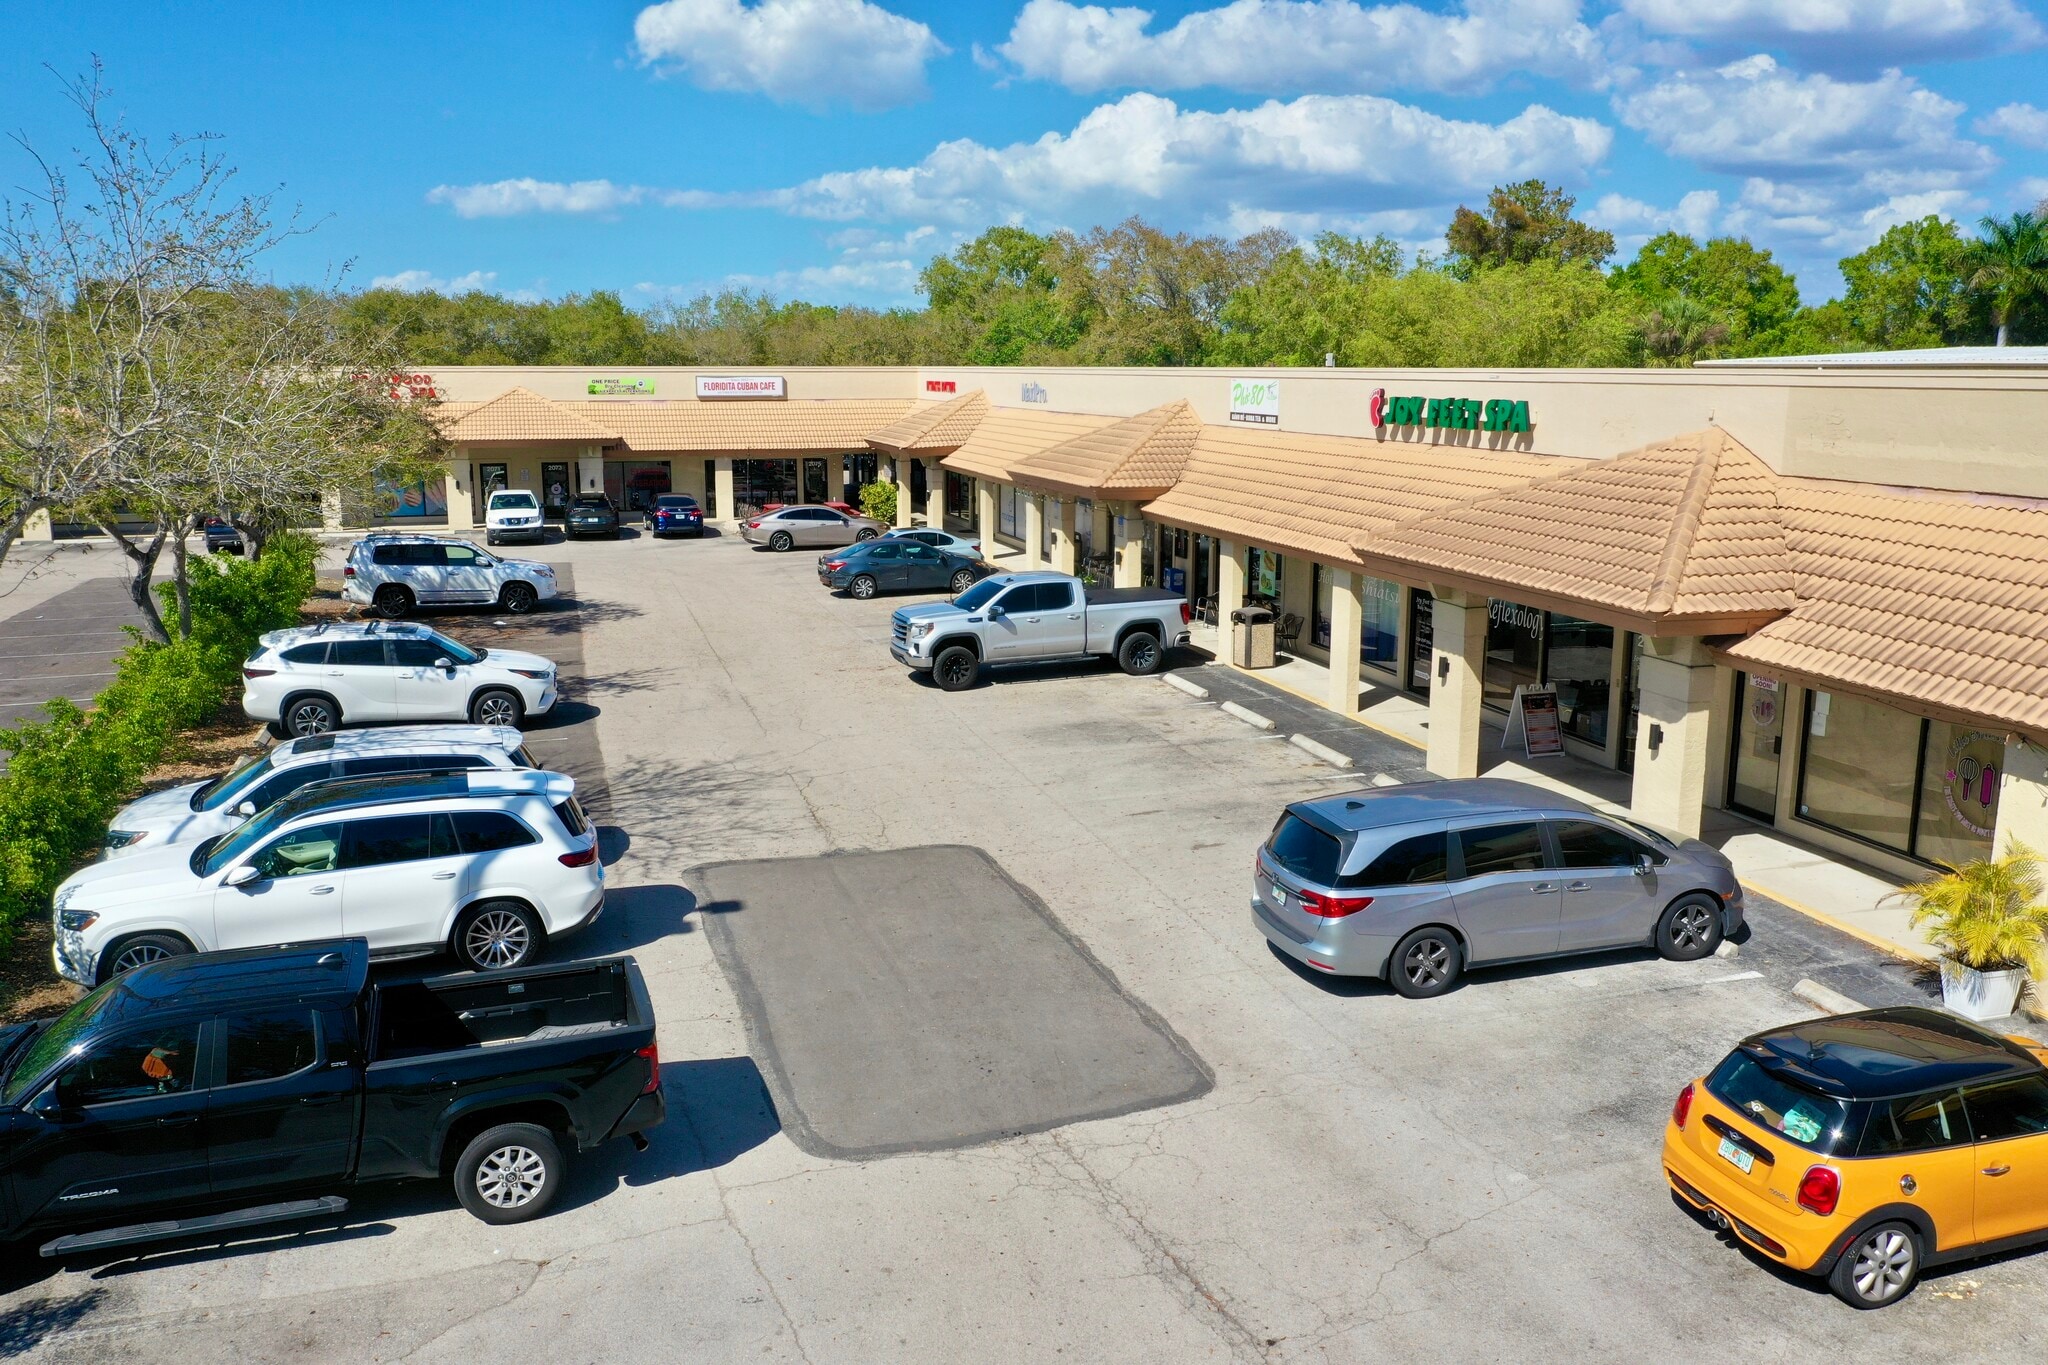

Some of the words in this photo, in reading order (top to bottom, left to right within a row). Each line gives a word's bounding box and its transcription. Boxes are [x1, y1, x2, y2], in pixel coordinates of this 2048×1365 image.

[704, 382, 736, 391] FLORIDITA
[737, 382, 758, 391] CUBAN
[759, 382, 776, 391] CAFE
[1384, 396, 1427, 426] JOY
[1426, 398, 1483, 430] FEET
[1484, 399, 1532, 432] SPA
[59, 1188, 119, 1201] TACOMA
